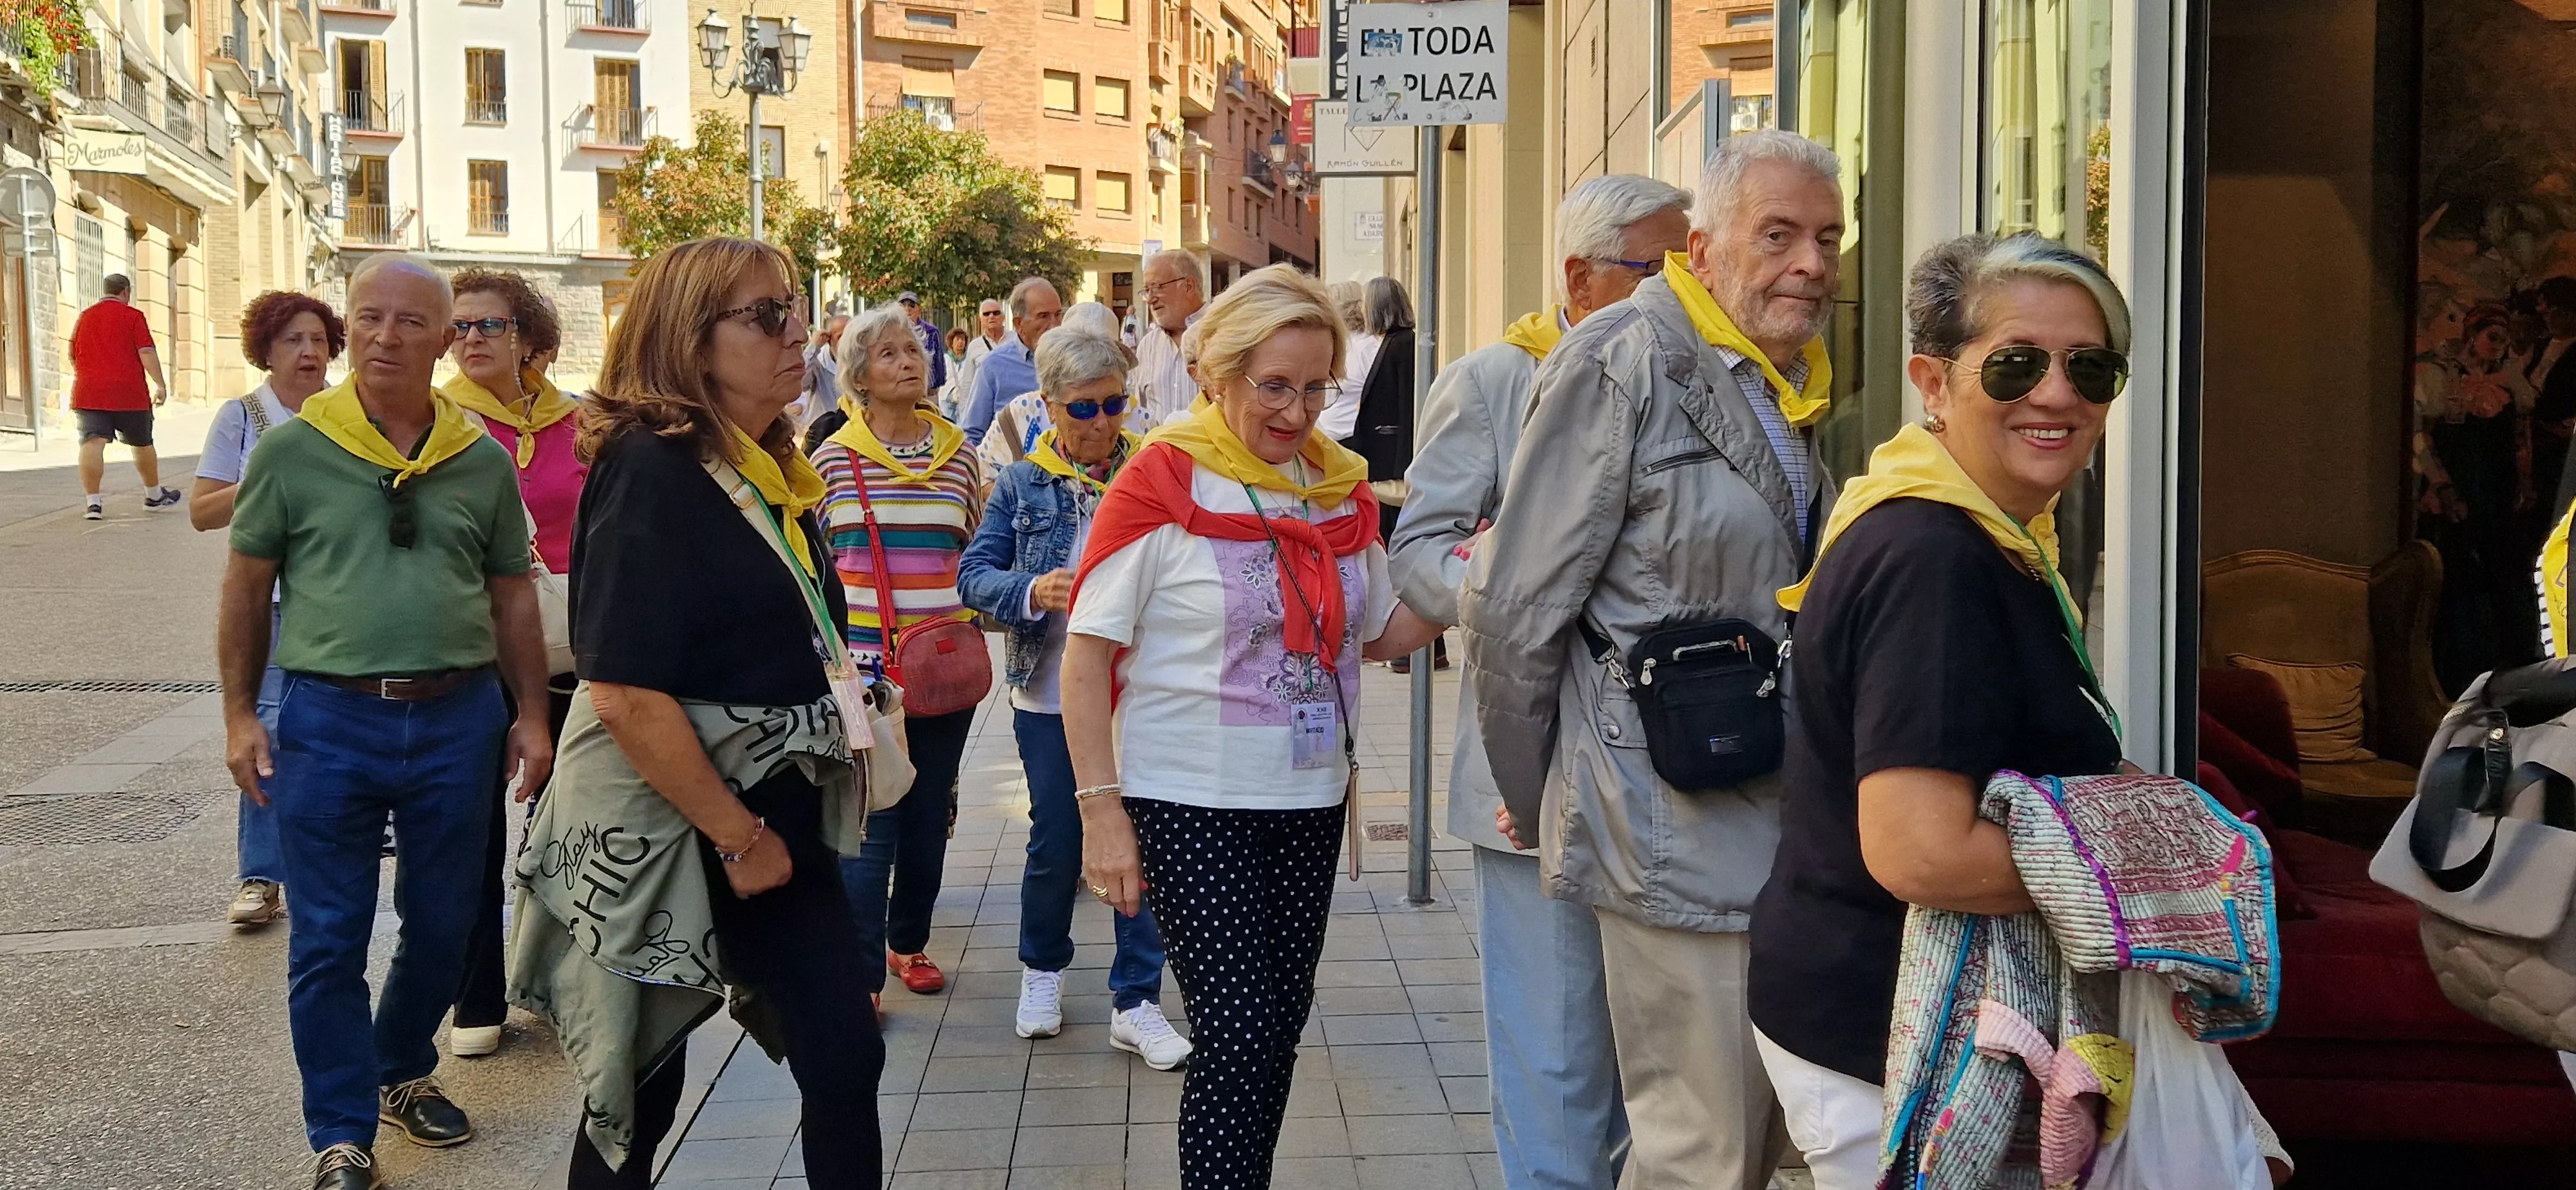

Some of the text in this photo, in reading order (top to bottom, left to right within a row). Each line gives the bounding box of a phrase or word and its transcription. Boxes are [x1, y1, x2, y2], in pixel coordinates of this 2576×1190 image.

[1408, 25, 1495, 56] TODA
[1403, 72, 1497, 102] PLAZA
[67, 137, 144, 166] Marmoles
[328, 115, 345, 217] HABITACIONES
[1327, 158, 1403, 169] RAMÓN GUILLÉN
